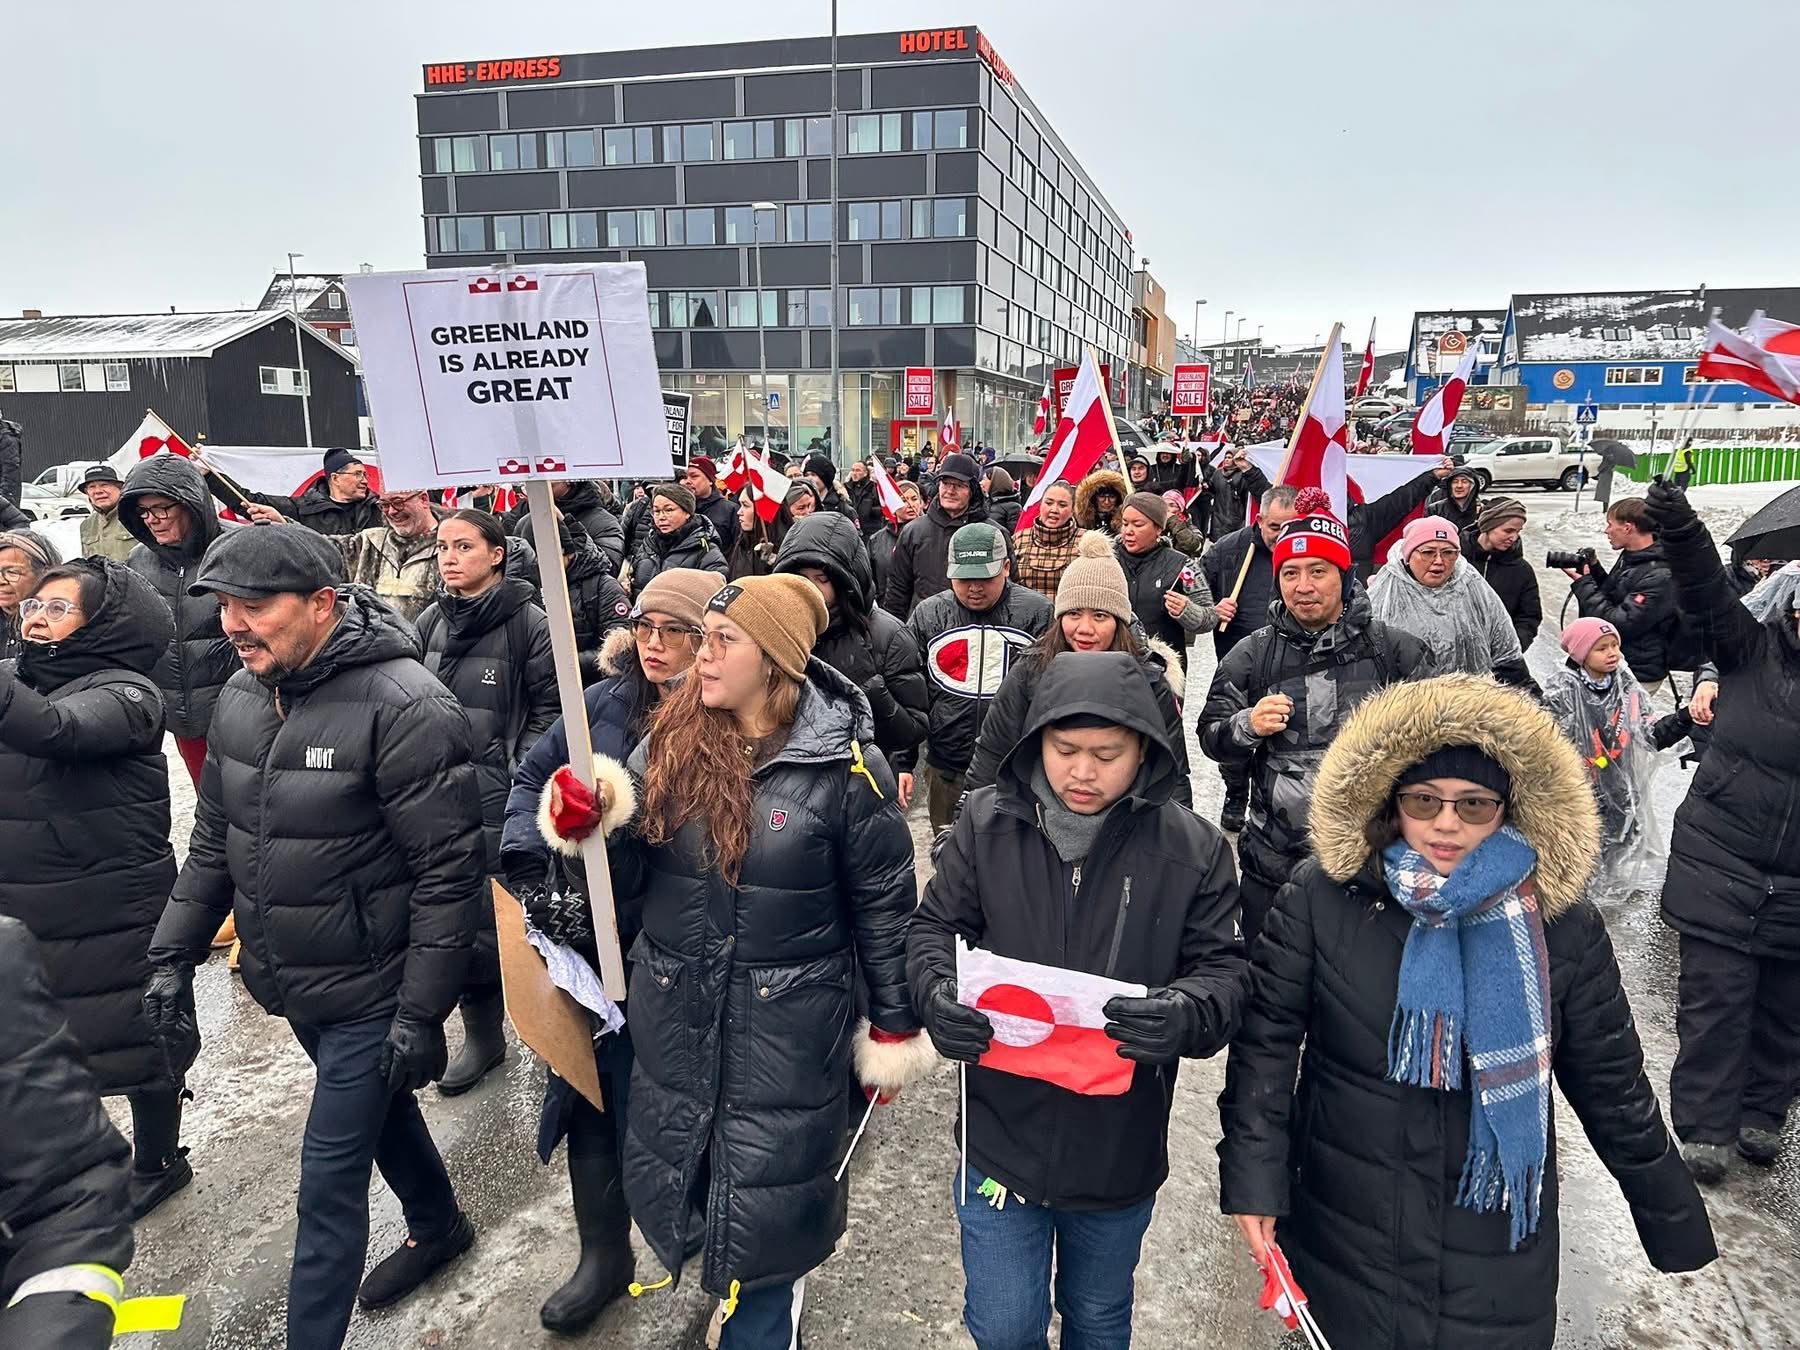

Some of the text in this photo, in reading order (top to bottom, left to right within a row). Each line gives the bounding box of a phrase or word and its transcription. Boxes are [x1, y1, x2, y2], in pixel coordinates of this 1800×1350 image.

[900, 30, 969, 54] HOTEL
[431, 320, 589, 346] GREENLAND
[439, 348, 590, 374] IS ALREADY
[467, 376, 573, 405] GREAT
[1177, 392, 1203, 406] SALE!
